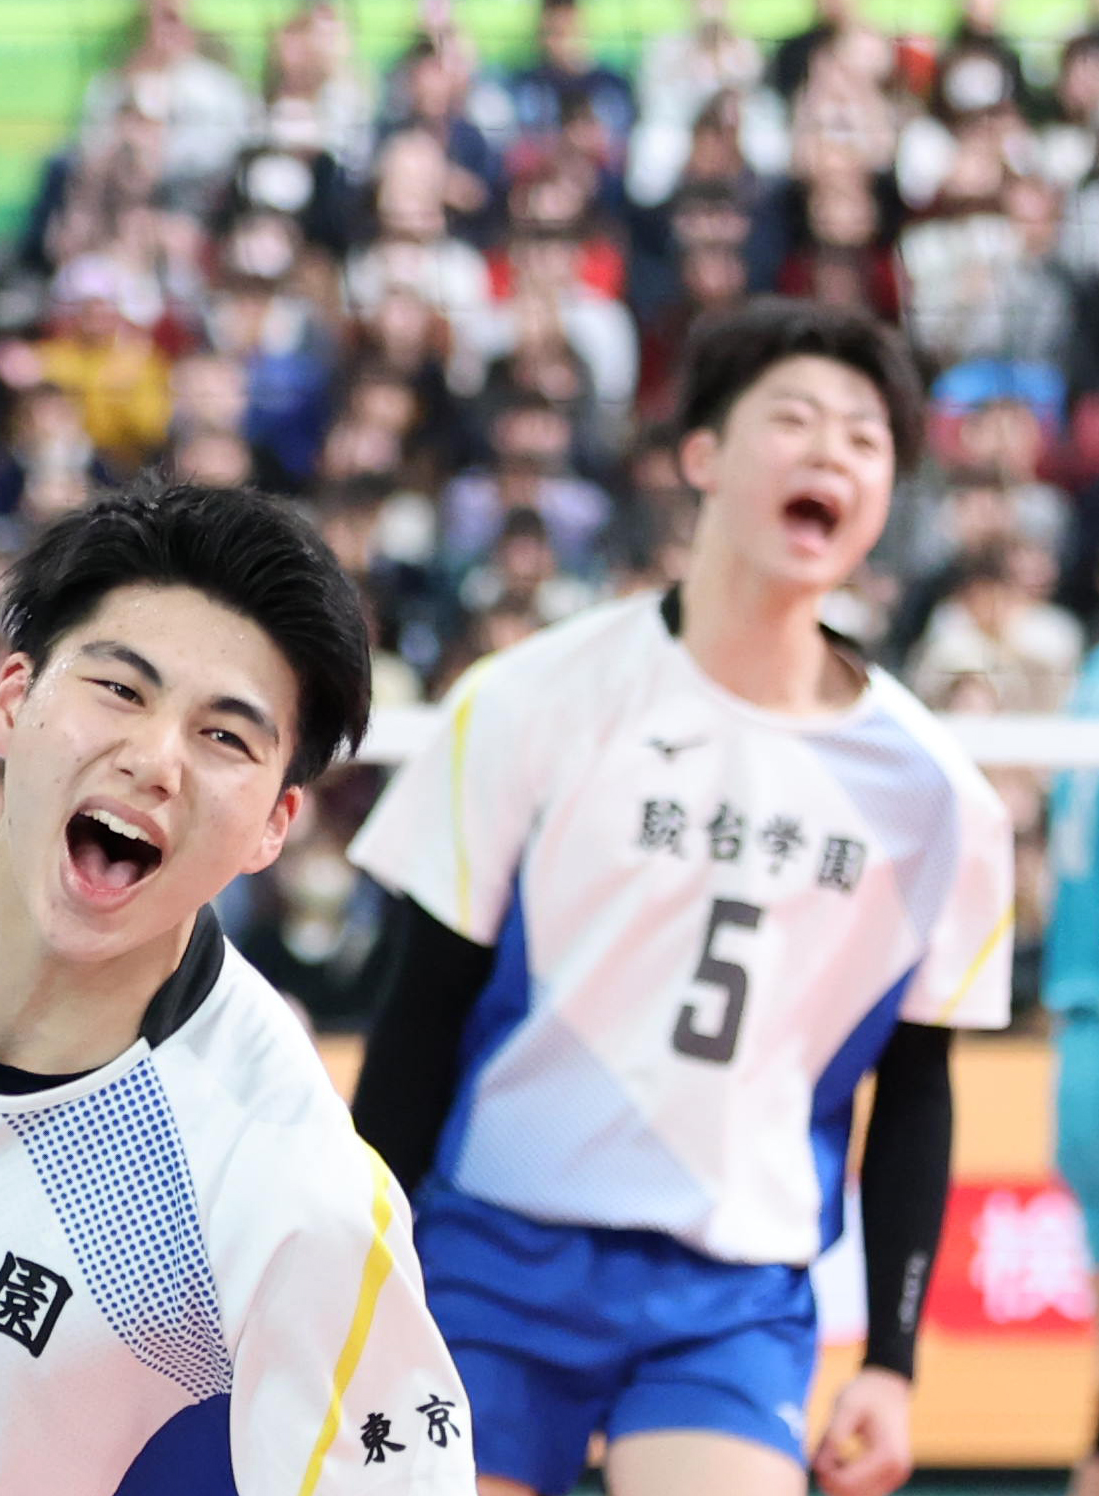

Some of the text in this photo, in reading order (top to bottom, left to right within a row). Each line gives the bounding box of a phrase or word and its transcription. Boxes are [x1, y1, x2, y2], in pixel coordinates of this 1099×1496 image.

[638, 799, 867, 893] 駿台学園
[673, 898, 762, 1062] 5
[360, 1393, 461, 1467] 東京
